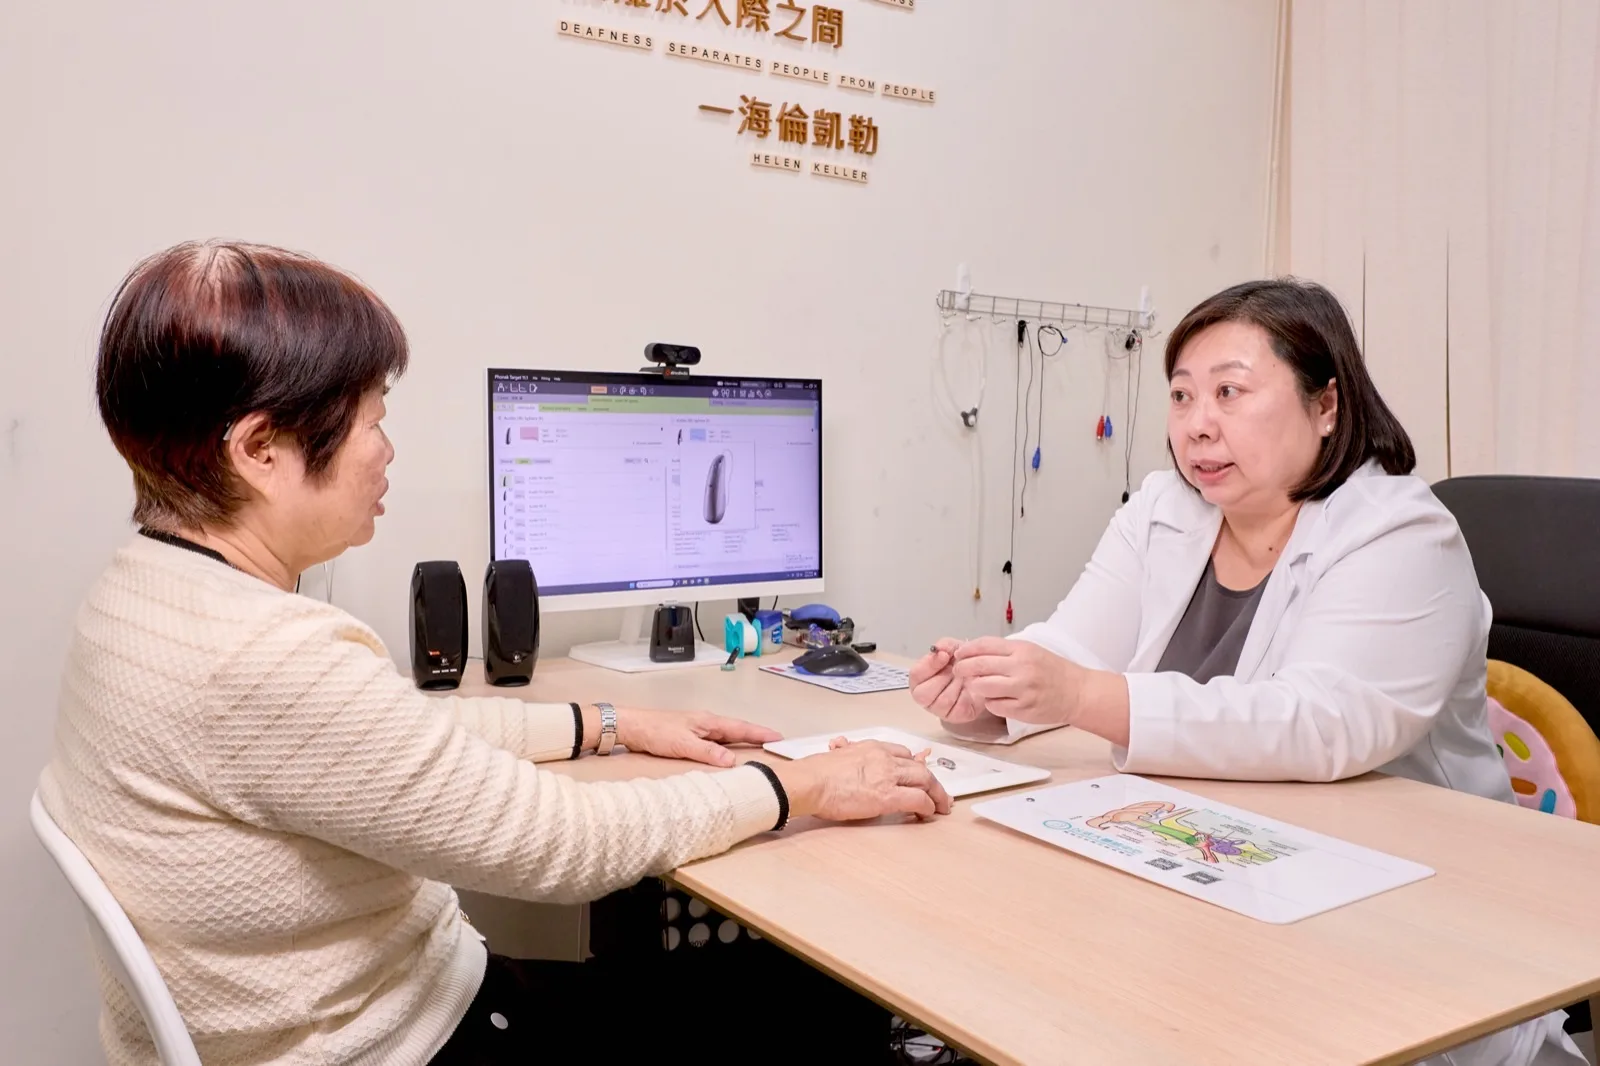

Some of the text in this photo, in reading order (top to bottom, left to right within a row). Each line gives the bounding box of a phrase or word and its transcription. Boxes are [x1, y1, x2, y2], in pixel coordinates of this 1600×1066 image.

[560, 21, 935, 100] DEAFNESS SEPARATES PEOPLE FROM PEOPLE
[753, 153, 867, 180] HELEN KELLER
